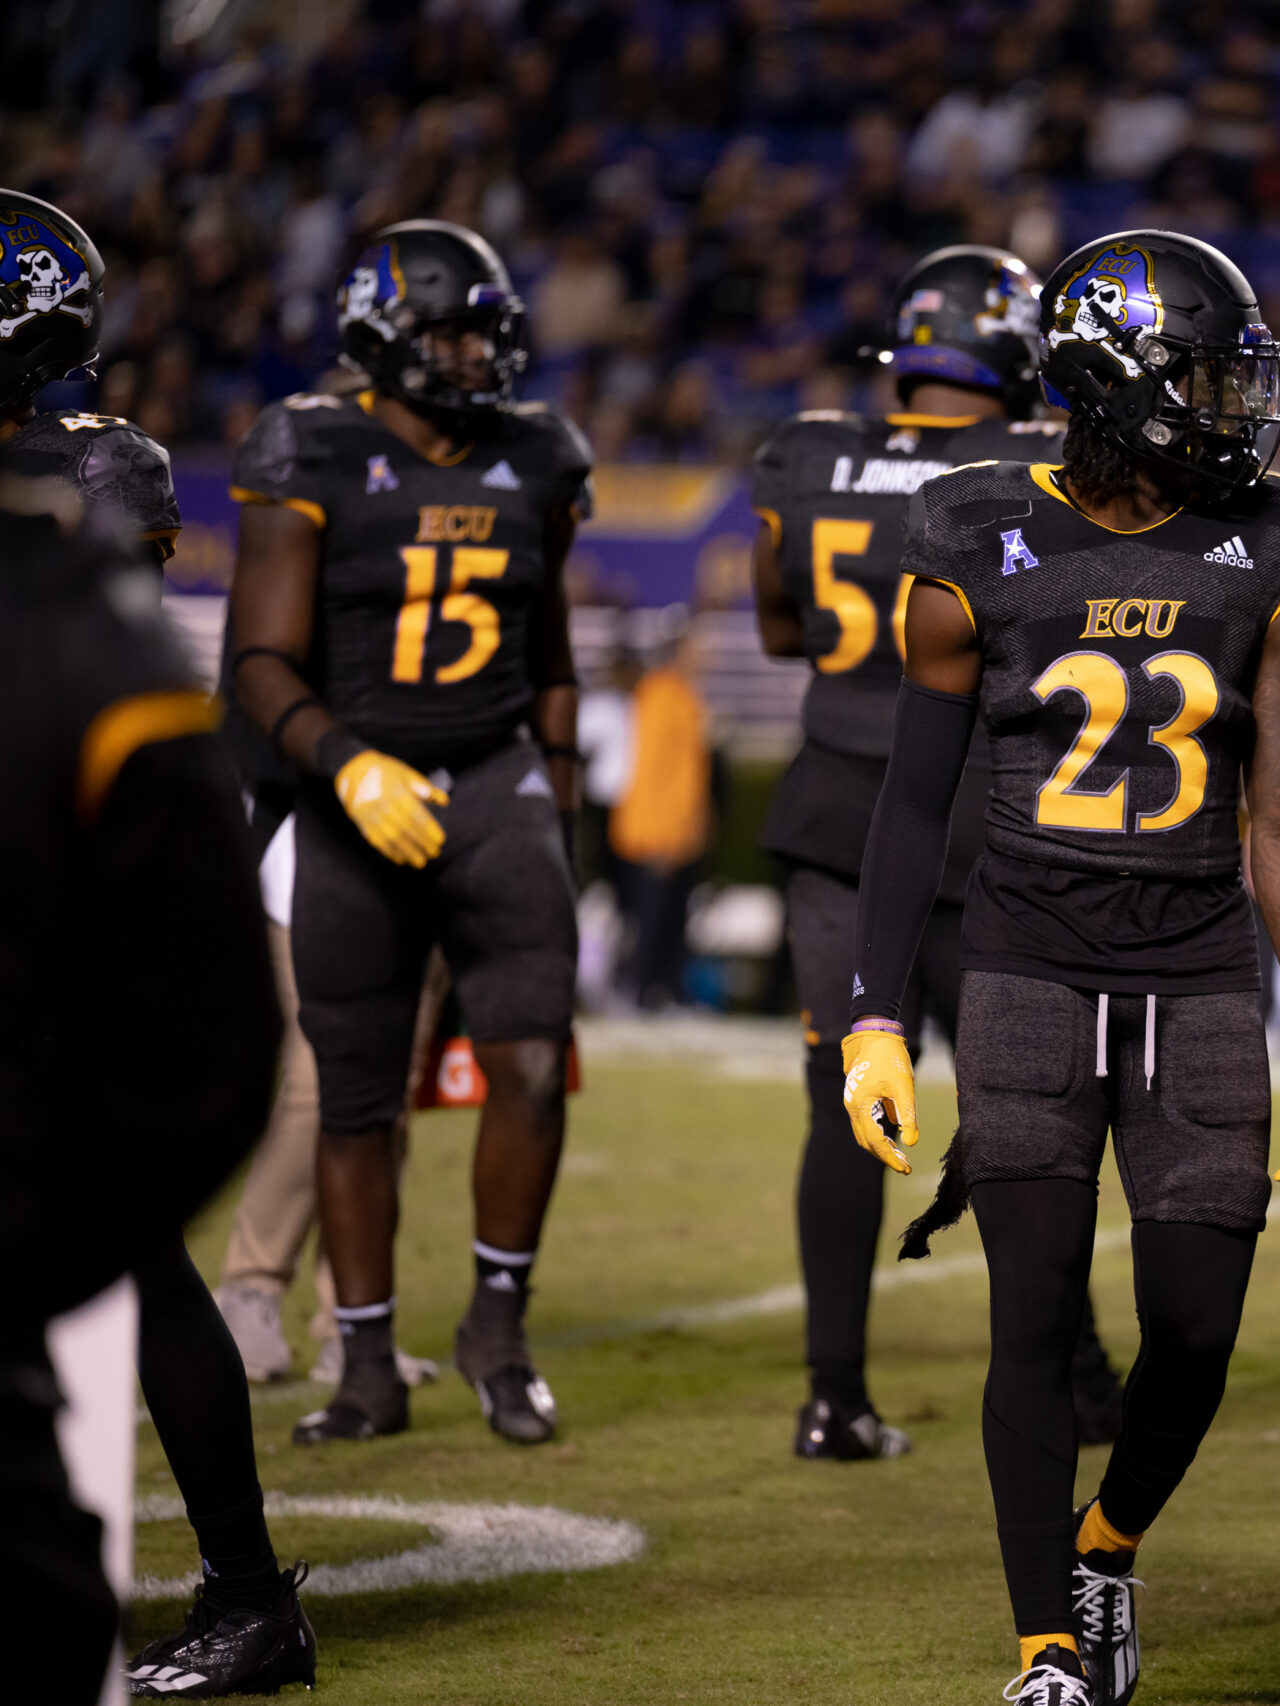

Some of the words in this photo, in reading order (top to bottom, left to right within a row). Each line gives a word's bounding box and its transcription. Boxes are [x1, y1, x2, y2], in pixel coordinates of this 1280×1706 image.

[7, 224, 40, 246] ECU
[1096, 257, 1138, 274] ECU
[415, 504, 498, 544] ECU
[1203, 549, 1254, 570] adidas
[390, 545, 510, 685] 15
[1078, 598, 1187, 639] ECU
[1029, 650, 1222, 834] 23
[436, 1050, 475, 1101] G
